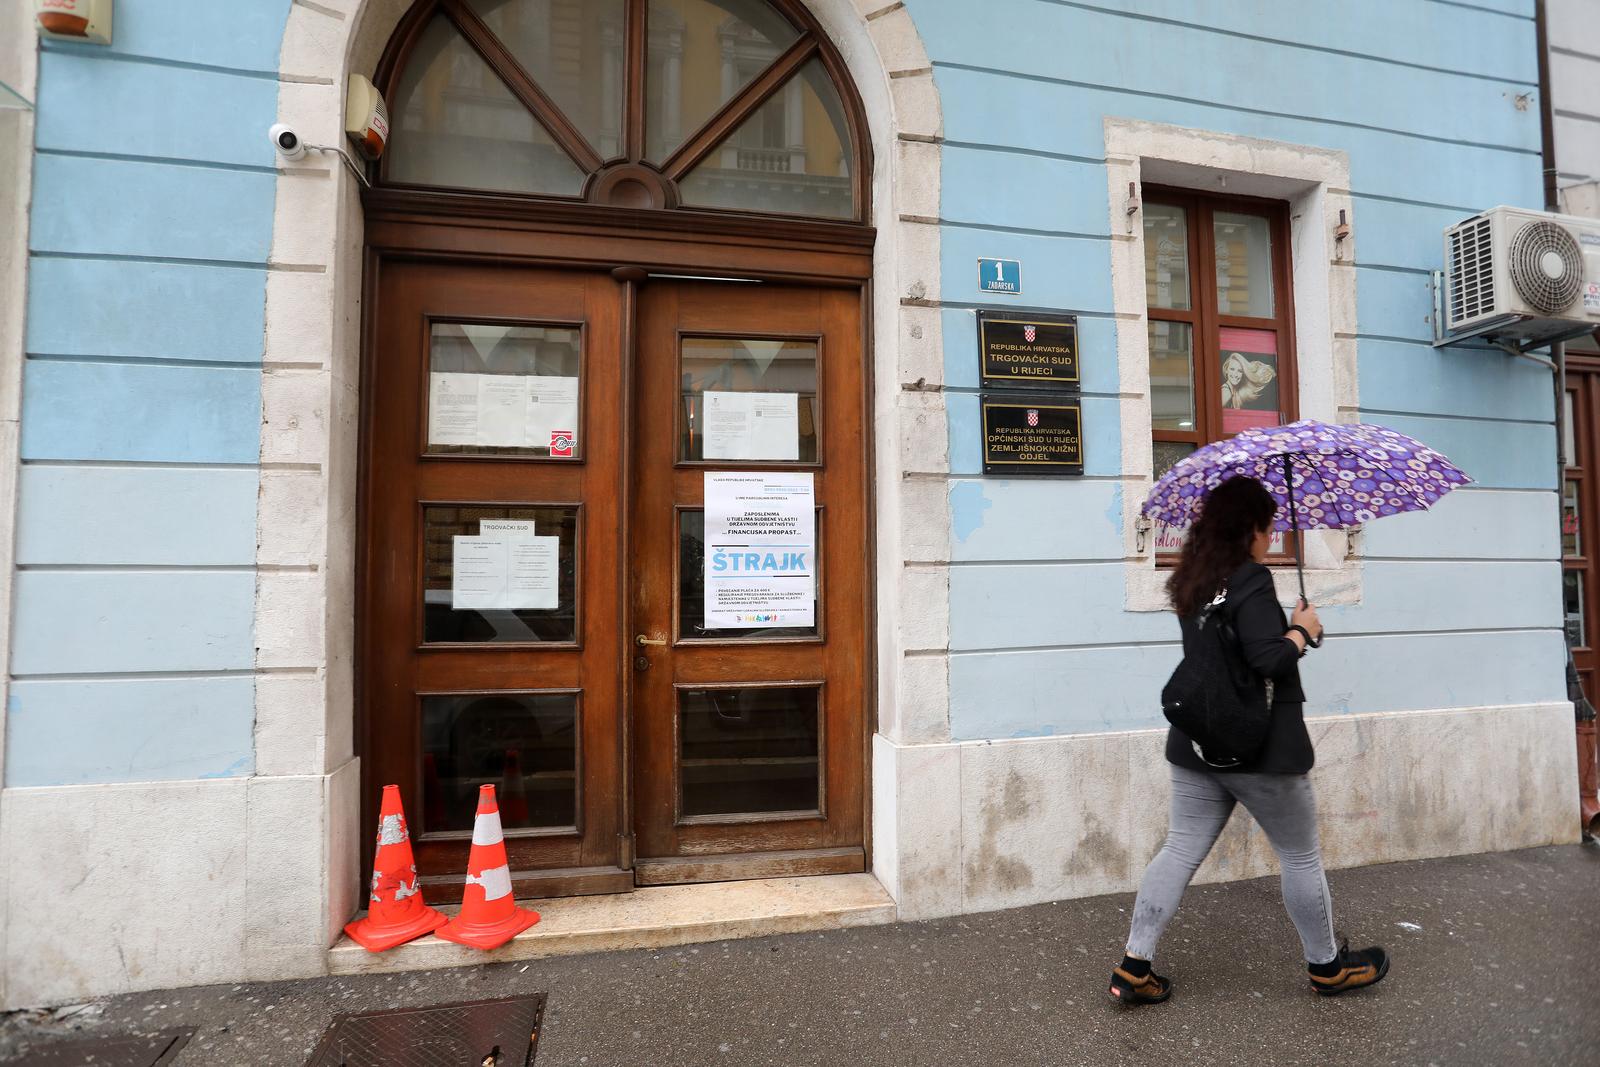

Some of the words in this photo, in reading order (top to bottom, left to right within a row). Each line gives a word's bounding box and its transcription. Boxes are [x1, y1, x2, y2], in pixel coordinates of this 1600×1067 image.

[995, 262, 1004, 281] 1
[987, 281, 1015, 291] ZADARSKA
[990, 343, 1032, 352] REPUBLIKA
[1033, 345, 1070, 353] HRVATSKA
[990, 354, 1049, 364] TRGOVAČKI
[1051, 356, 1072, 365] SUD
[1011, 366, 1019, 374] U
[1021, 366, 1053, 375] RIJECI
[988, 435, 1026, 443] OPĆINSKI
[1053, 436, 1078, 444] RIJECI
[991, 444, 1077, 453] ZEMLJIŠNOKNJIŽNI
[712, 548, 806, 571] ŠTRAJK
